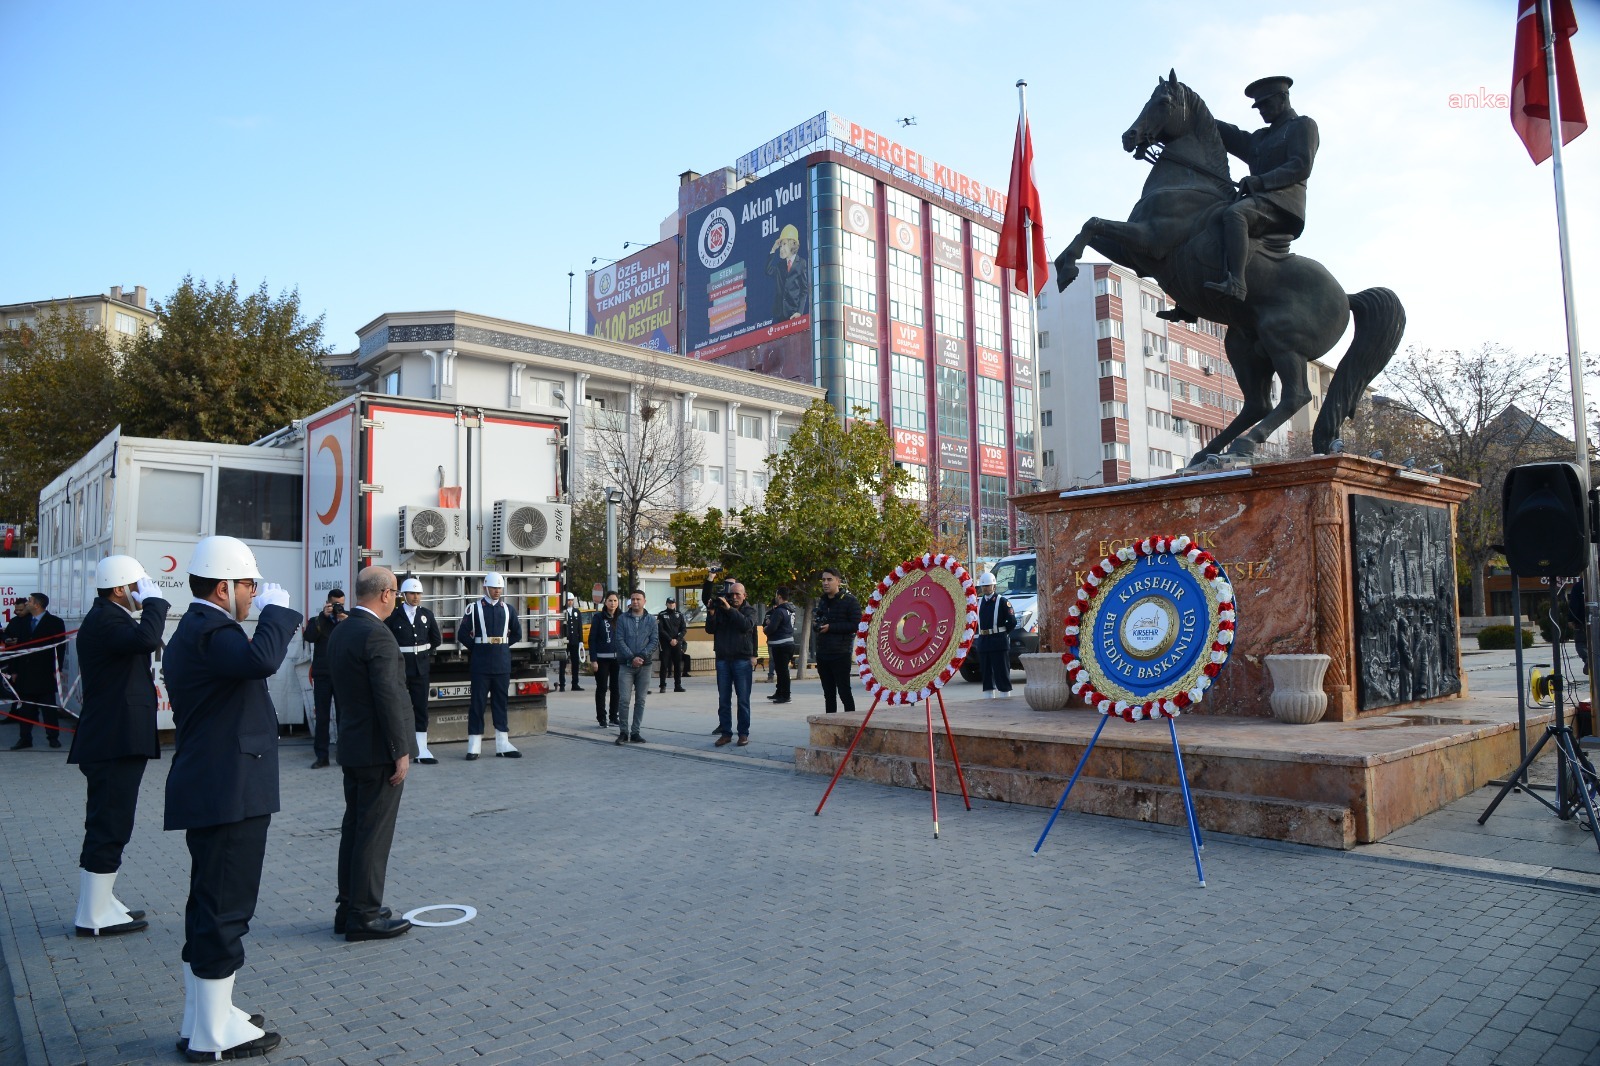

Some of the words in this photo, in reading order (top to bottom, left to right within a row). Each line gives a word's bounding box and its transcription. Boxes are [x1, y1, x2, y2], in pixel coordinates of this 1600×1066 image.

[737, 153, 755, 181] BİL
[757, 112, 826, 171] KOLEJLERİ
[850, 122, 929, 179] PERGEL
[933, 161, 982, 203] KURS
[741, 197, 773, 225] Aklın
[775, 182, 802, 208] Yolu
[762, 213, 779, 238] BİL
[617, 260, 642, 280] ÖZEL
[617, 275, 638, 292] OSB
[640, 260, 670, 283] BİLİM
[719, 268, 733, 279] STEM
[596, 289, 632, 312] TEKNİK
[634, 271, 670, 298] KOLEJİ
[628, 289, 665, 320] DEVLET
[627, 302, 672, 340] DESTEKLİ
[850, 311, 873, 328] TUS
[899, 325, 917, 341] VİP
[945, 339, 958, 353] 20
[896, 430, 925, 448] KPSS
[905, 446, 918, 456] A-B
[985, 447, 1002, 460] YDS
[1021, 455, 1035, 470] AÖ
[554, 508, 563, 542] arçelik
[322, 533, 336, 547] TÜRK
[314, 547, 344, 569] KIZILAY
[0, 586, 17, 596] T.C.
[152, 580, 185, 588] KIZILAY
[911, 586, 931, 598] T.C.
[1118, 576, 1186, 604] KIRŞEHİR
[880, 620, 905, 671] KIRŞEHİR
[909, 618, 949, 669] VALİLİĞİ
[1103, 612, 1134, 677] BELEDİYE
[1136, 608, 1197, 679] BAŞKANLIĞI
[452, 687, 461, 696] JP
